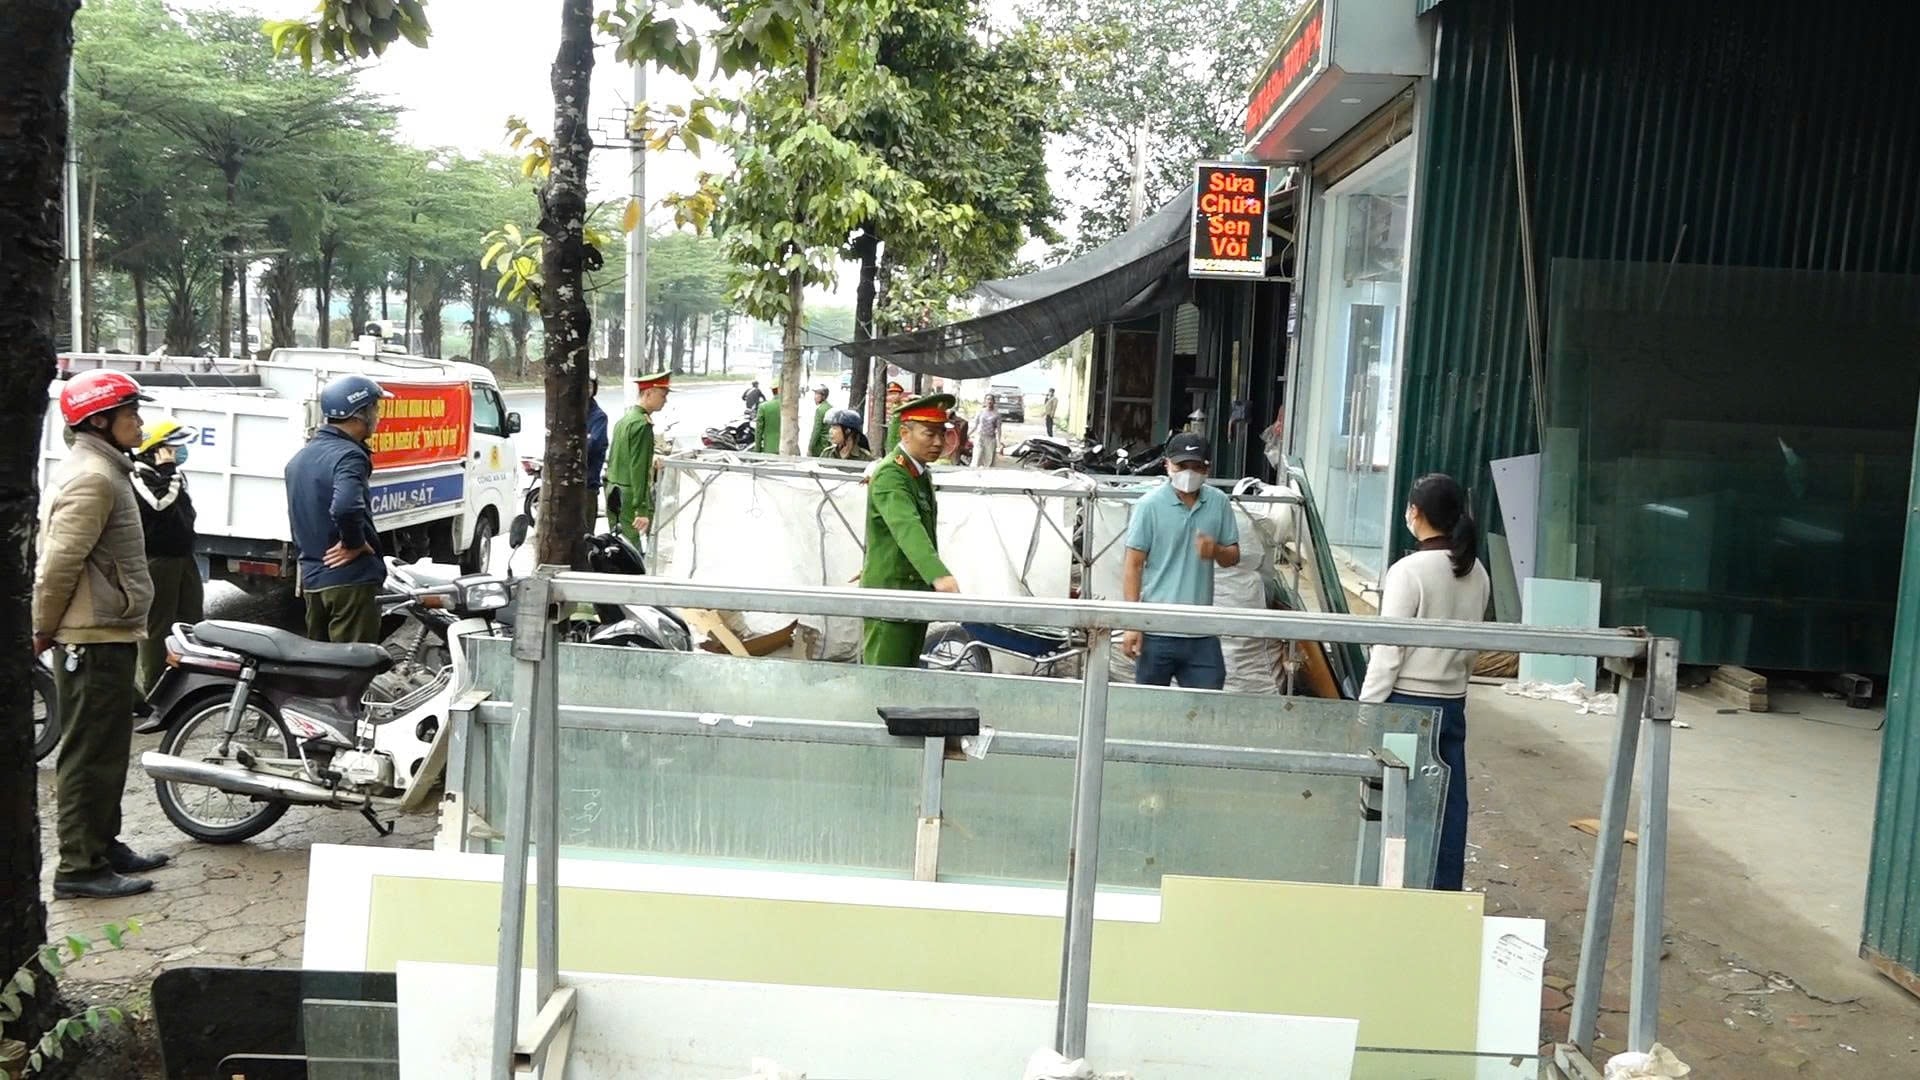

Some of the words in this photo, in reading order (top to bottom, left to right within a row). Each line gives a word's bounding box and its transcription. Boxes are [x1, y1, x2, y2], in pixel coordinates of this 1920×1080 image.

[1208, 171, 1255, 193] Sửa
[1200, 193, 1262, 215] Chữa
[1208, 214, 1251, 236] Sen
[1210, 236, 1248, 257] Vòi
[370, 487, 407, 513] CẢNH
[410, 483, 434, 506] SÁT
